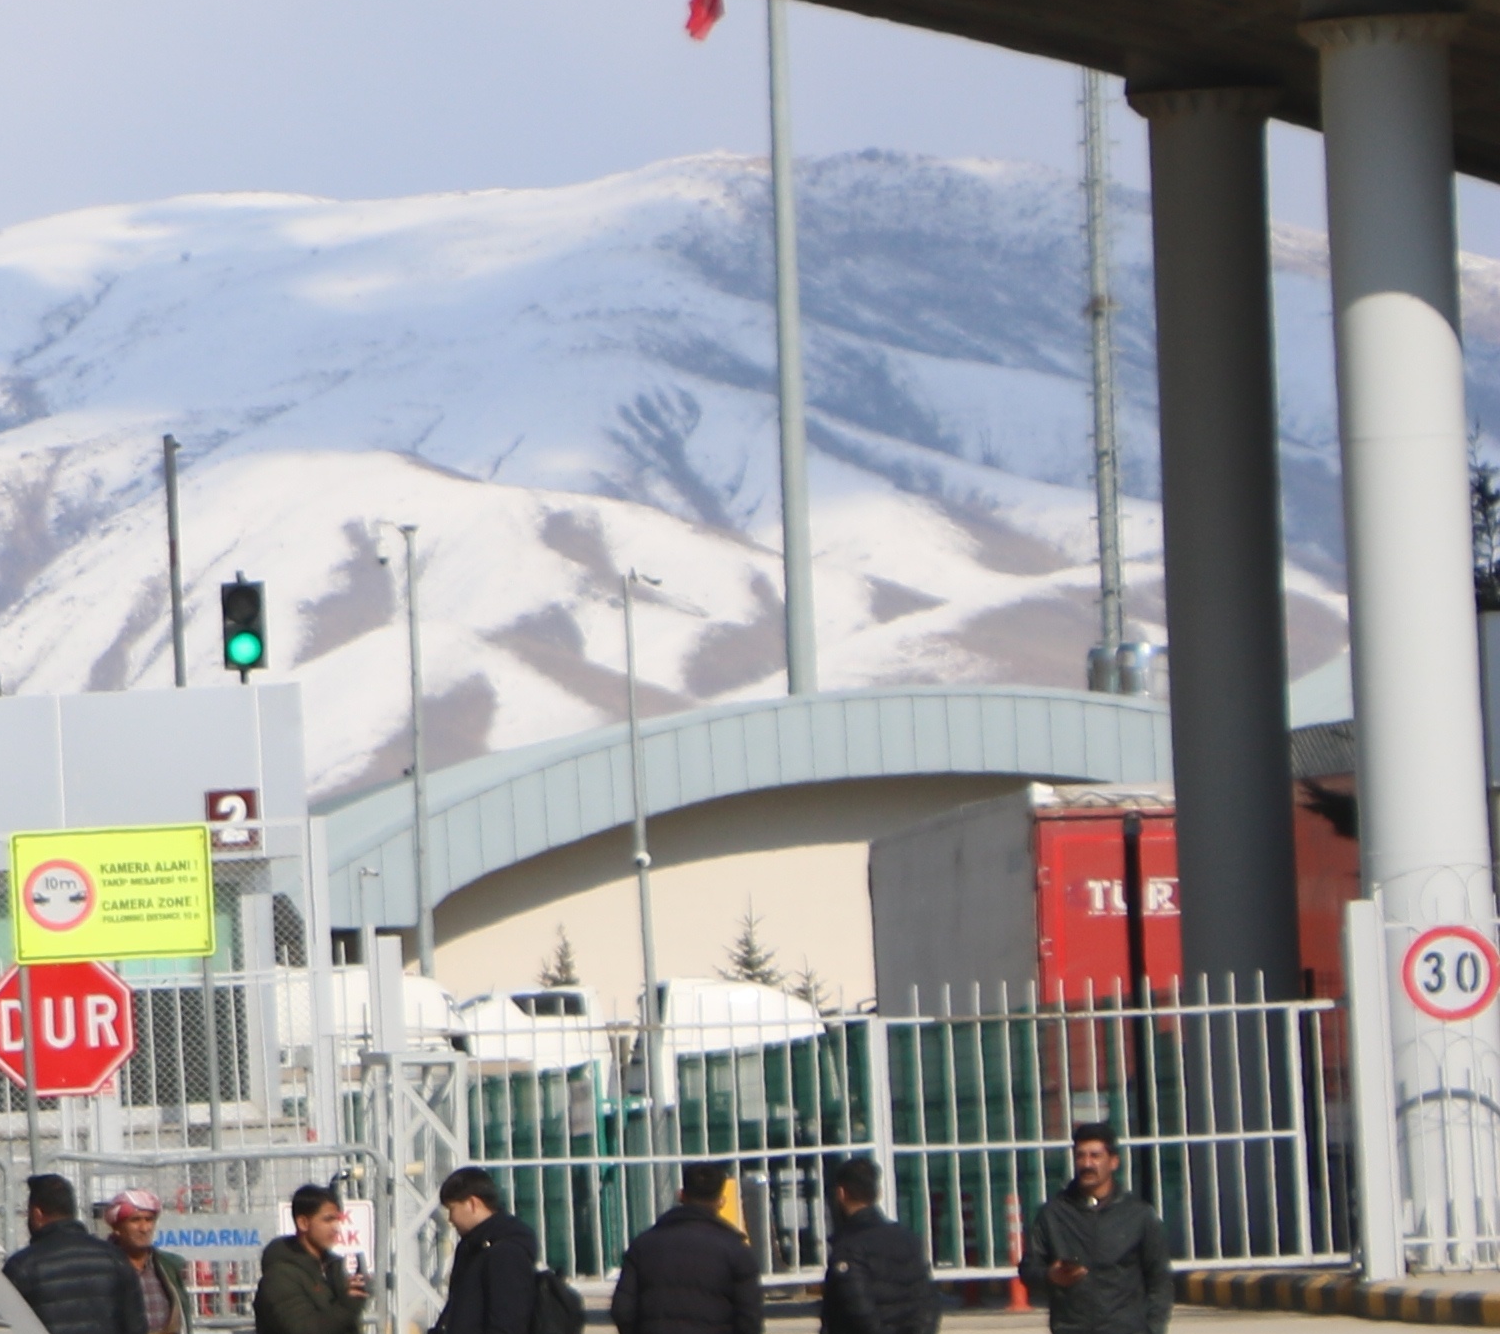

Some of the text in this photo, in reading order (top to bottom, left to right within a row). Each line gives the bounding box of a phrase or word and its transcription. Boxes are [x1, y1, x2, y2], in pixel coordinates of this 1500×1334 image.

[217, 795, 250, 842] 2
[99, 861, 151, 874] KAMERA
[155, 859, 191, 872] ALANI
[101, 897, 155, 911] CAMERA
[158, 895, 192, 908] ZONE
[1423, 951, 1482, 994] 30
[0, 994, 120, 1053] DUR
[154, 1228, 262, 1249] JANDARMA
